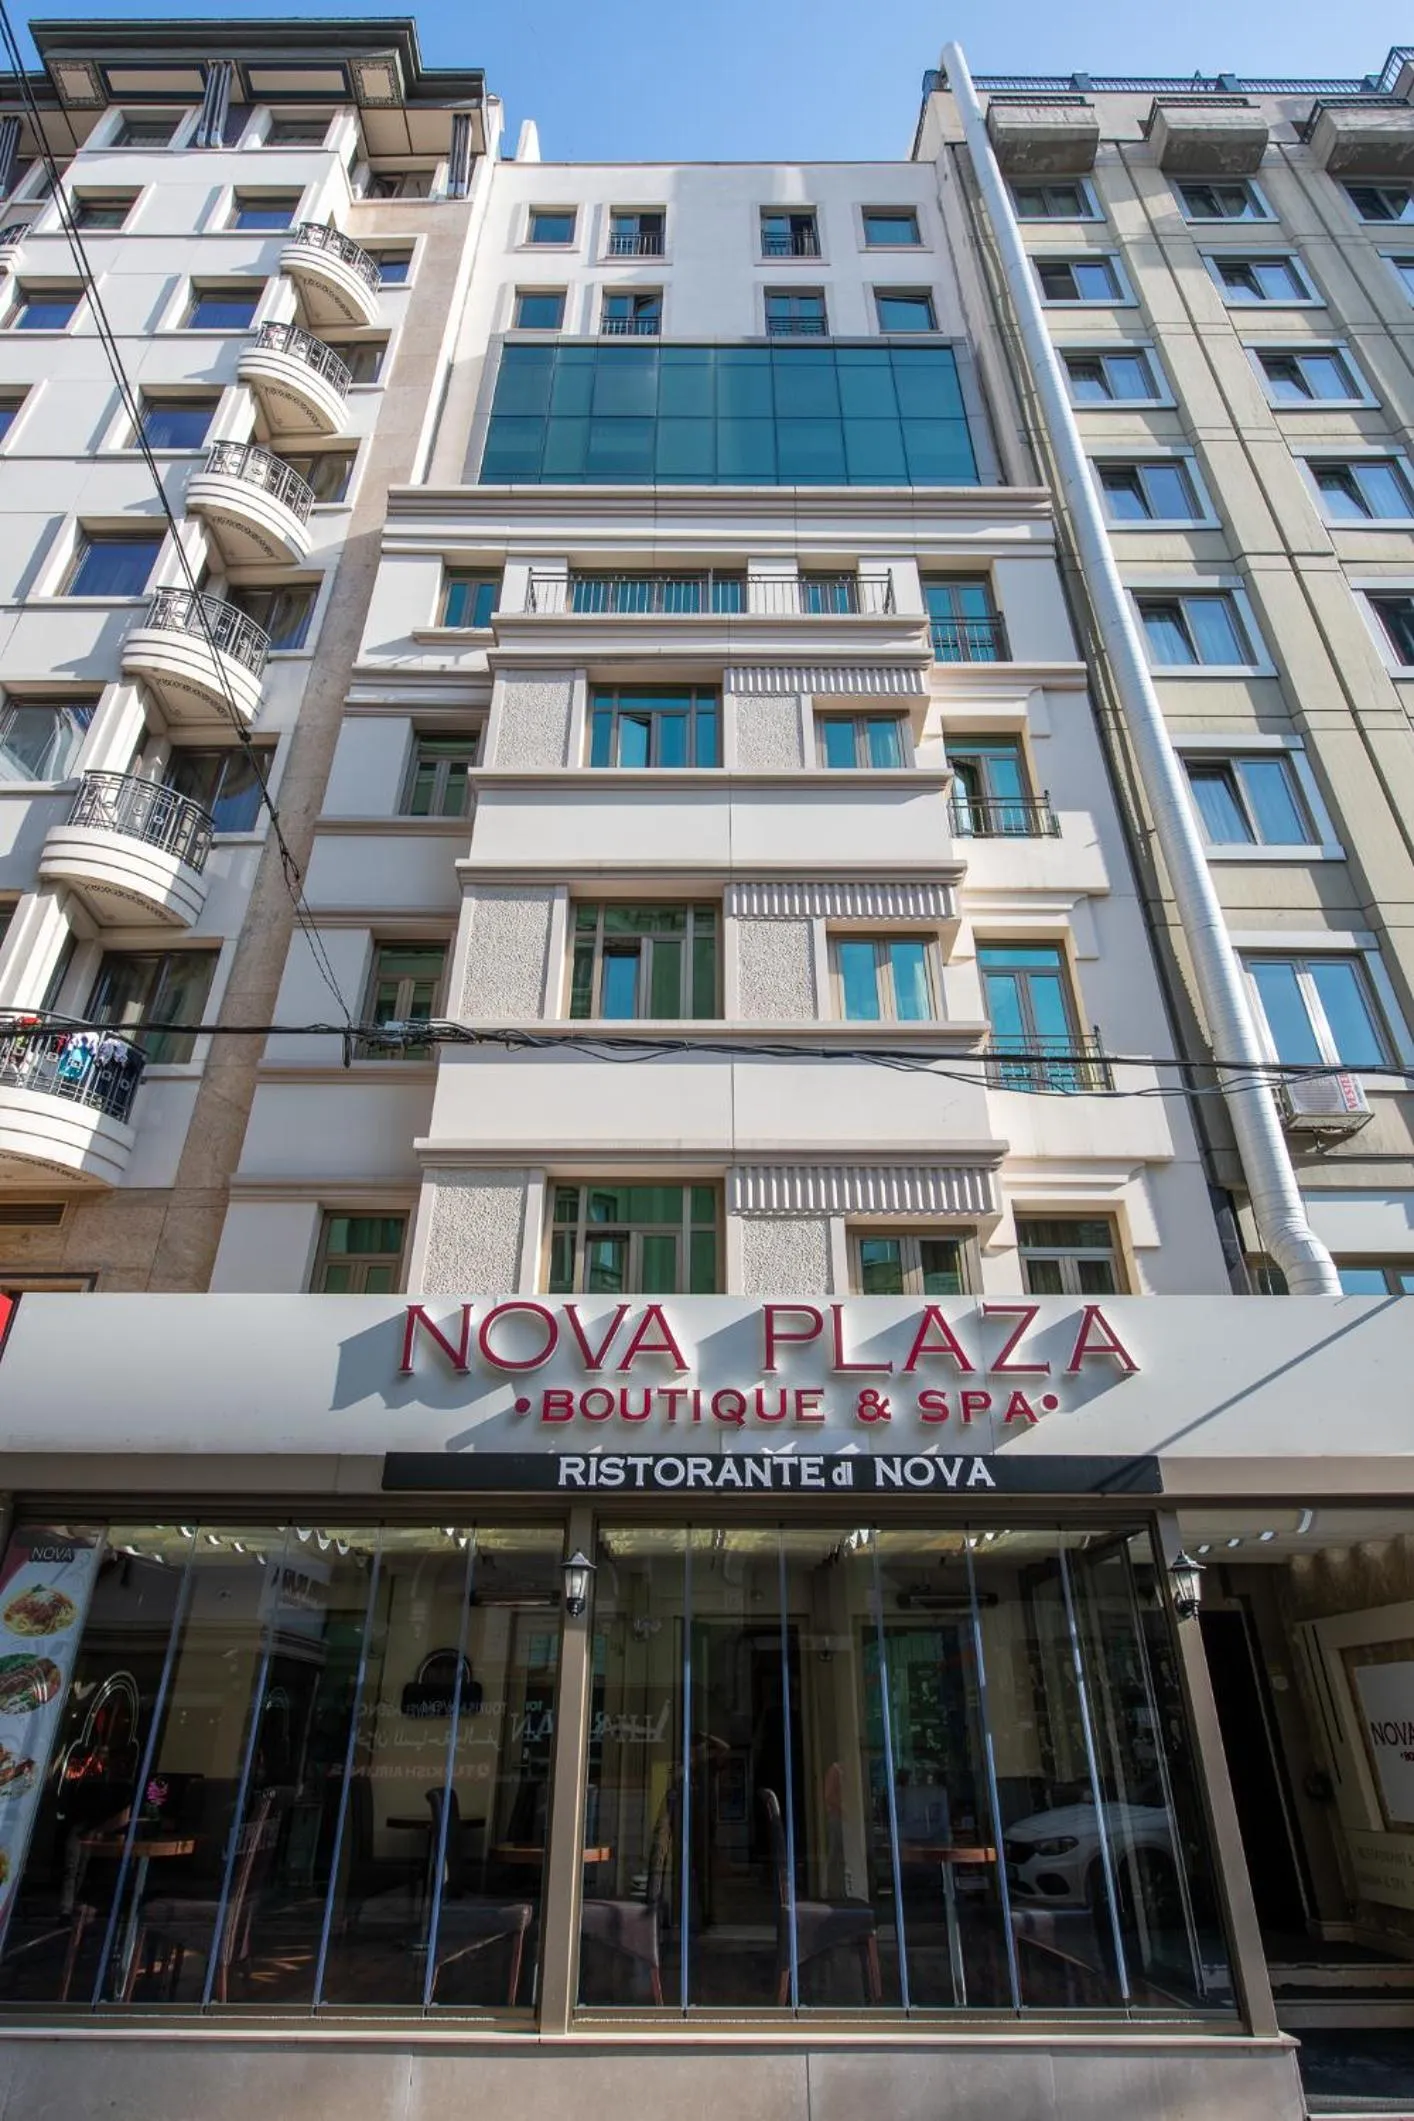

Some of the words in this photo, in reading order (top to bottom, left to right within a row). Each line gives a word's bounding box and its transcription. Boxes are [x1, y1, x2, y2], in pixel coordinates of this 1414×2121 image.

[399, 1301, 691, 1374] NOVA
[762, 1303, 1142, 1374] PLAZA
[541, 1387, 826, 1429] BOUTIQUE
[856, 1388, 892, 1424] &
[917, 1389, 1040, 1424] SPA
[557, 1456, 825, 1488] RISTORANTE
[874, 1456, 997, 1488] NOVA
[32, 1546, 72, 1561] NOVA
